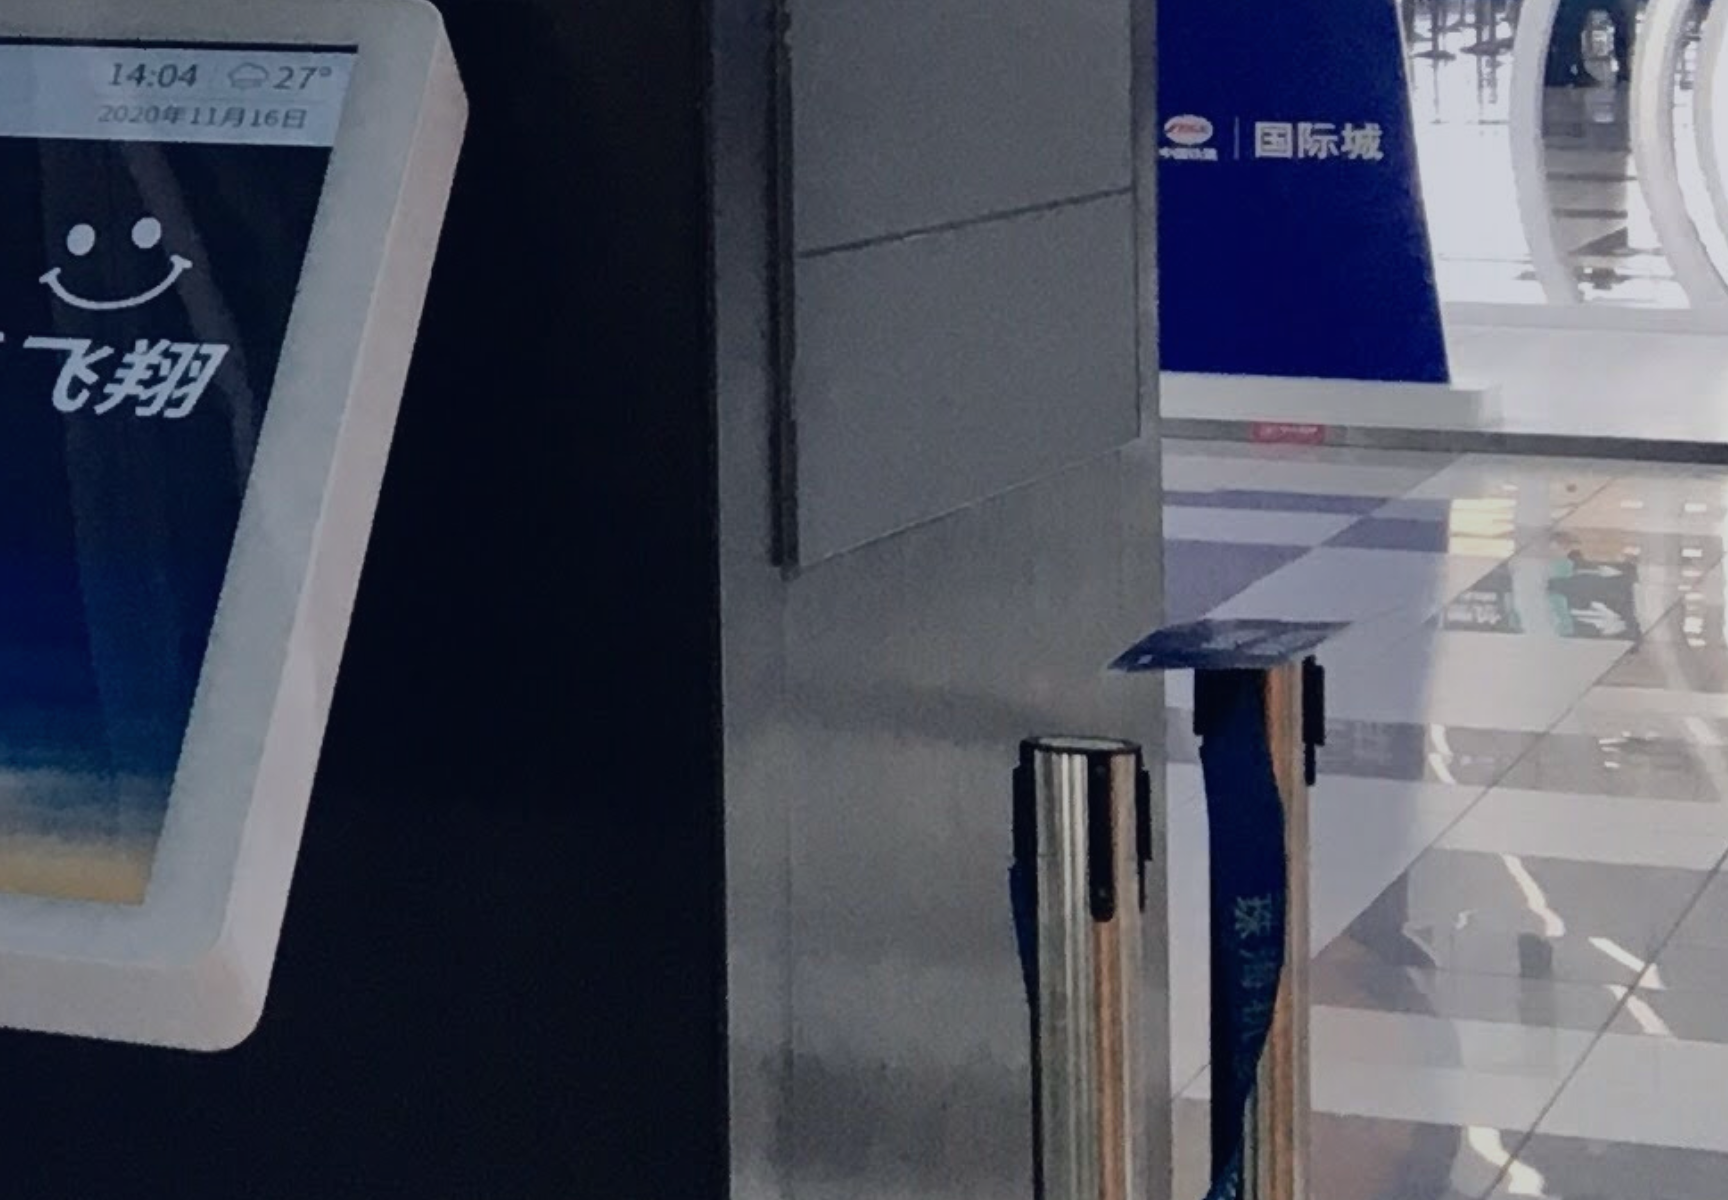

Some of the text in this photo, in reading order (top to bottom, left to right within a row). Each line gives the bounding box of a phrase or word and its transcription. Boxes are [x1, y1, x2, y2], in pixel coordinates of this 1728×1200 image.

[108, 62, 333, 90] 14:04 27°
[1255, 120, 1384, 162] 国际城
